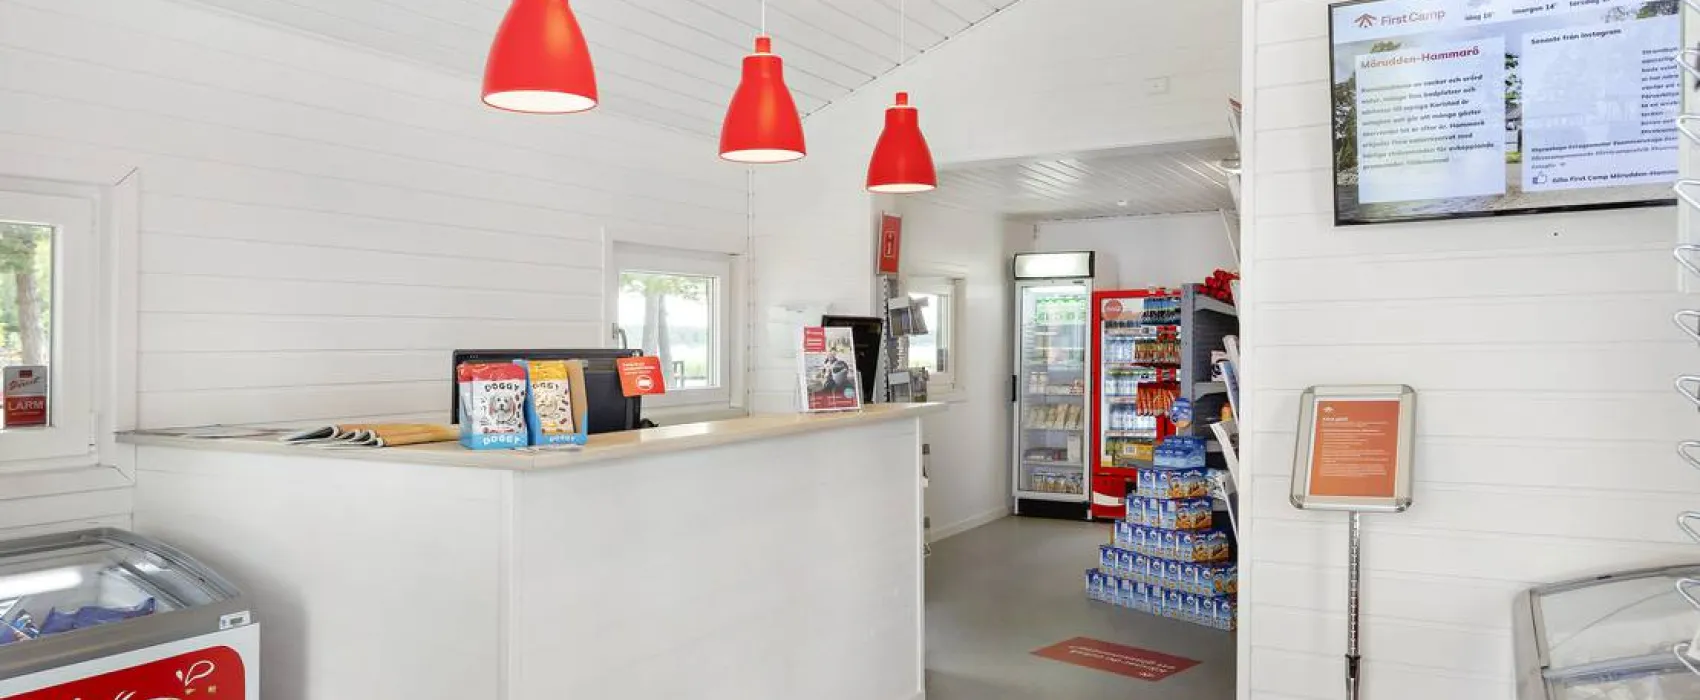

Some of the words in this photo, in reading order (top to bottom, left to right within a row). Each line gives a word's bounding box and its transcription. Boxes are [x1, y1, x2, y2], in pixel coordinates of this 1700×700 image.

[1381, 14, 1407, 26] First
[1409, 10, 1446, 22] Camp
[1531, 35, 1560, 45] Senaste
[1562, 33, 1579, 41] från
[1361, 46, 1480, 68] Mörudden-Hammarö
[484, 382, 520, 393] DOGGY
[8, 401, 44, 410] LARM
[483, 434, 521, 446] DOGGY
